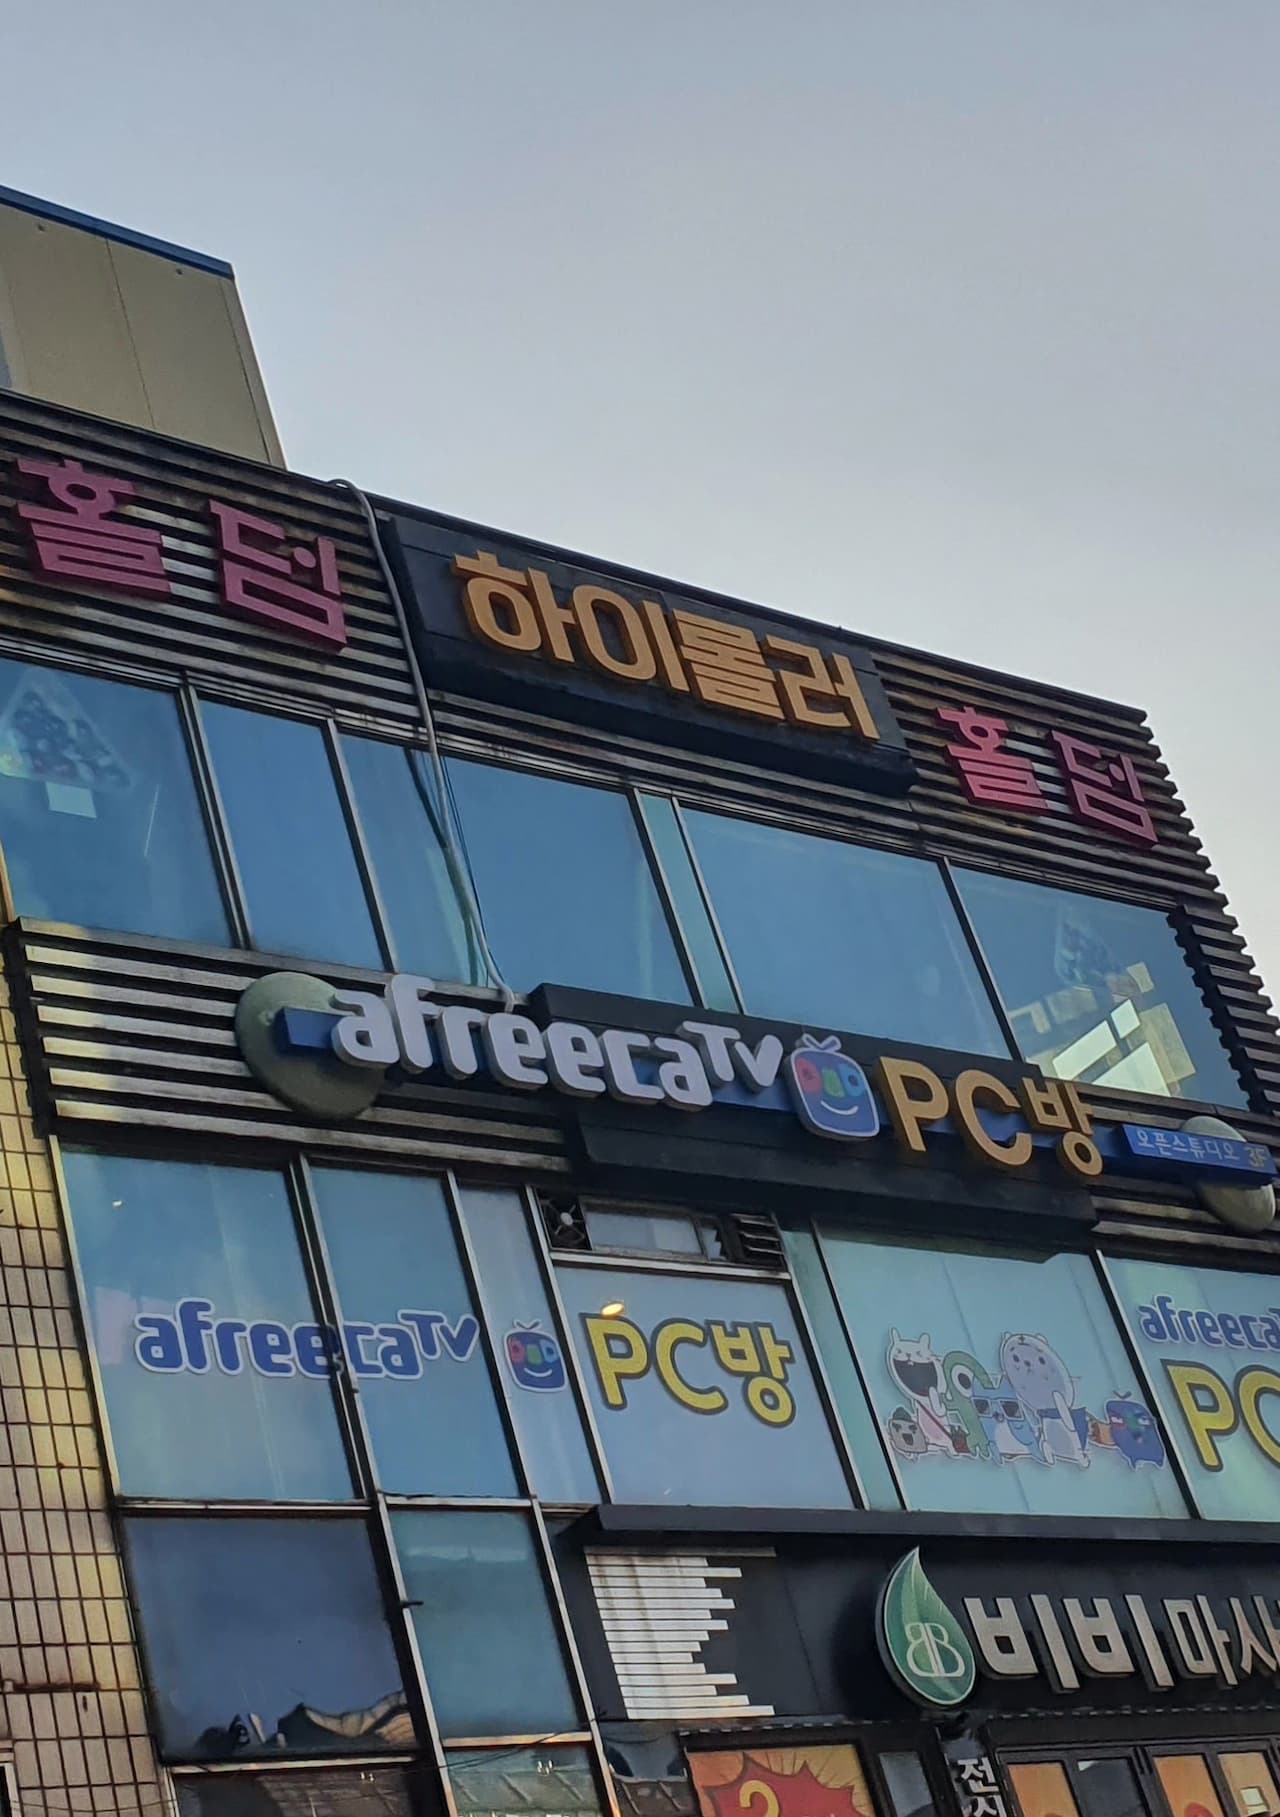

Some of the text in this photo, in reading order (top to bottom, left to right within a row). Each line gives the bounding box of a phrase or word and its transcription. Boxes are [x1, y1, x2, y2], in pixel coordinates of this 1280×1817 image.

[16, 458, 348, 652] 홀덤
[451, 550, 880, 741] 하이롤러
[935, 705, 1157, 845] 홀덤
[330, 973, 784, 1111] afreecaTV
[872, 1056, 1104, 1176] PC방
[1136, 1129, 1240, 1159] 오픈스튜디오
[131, 1298, 796, 1426] afreecaTV PC방
